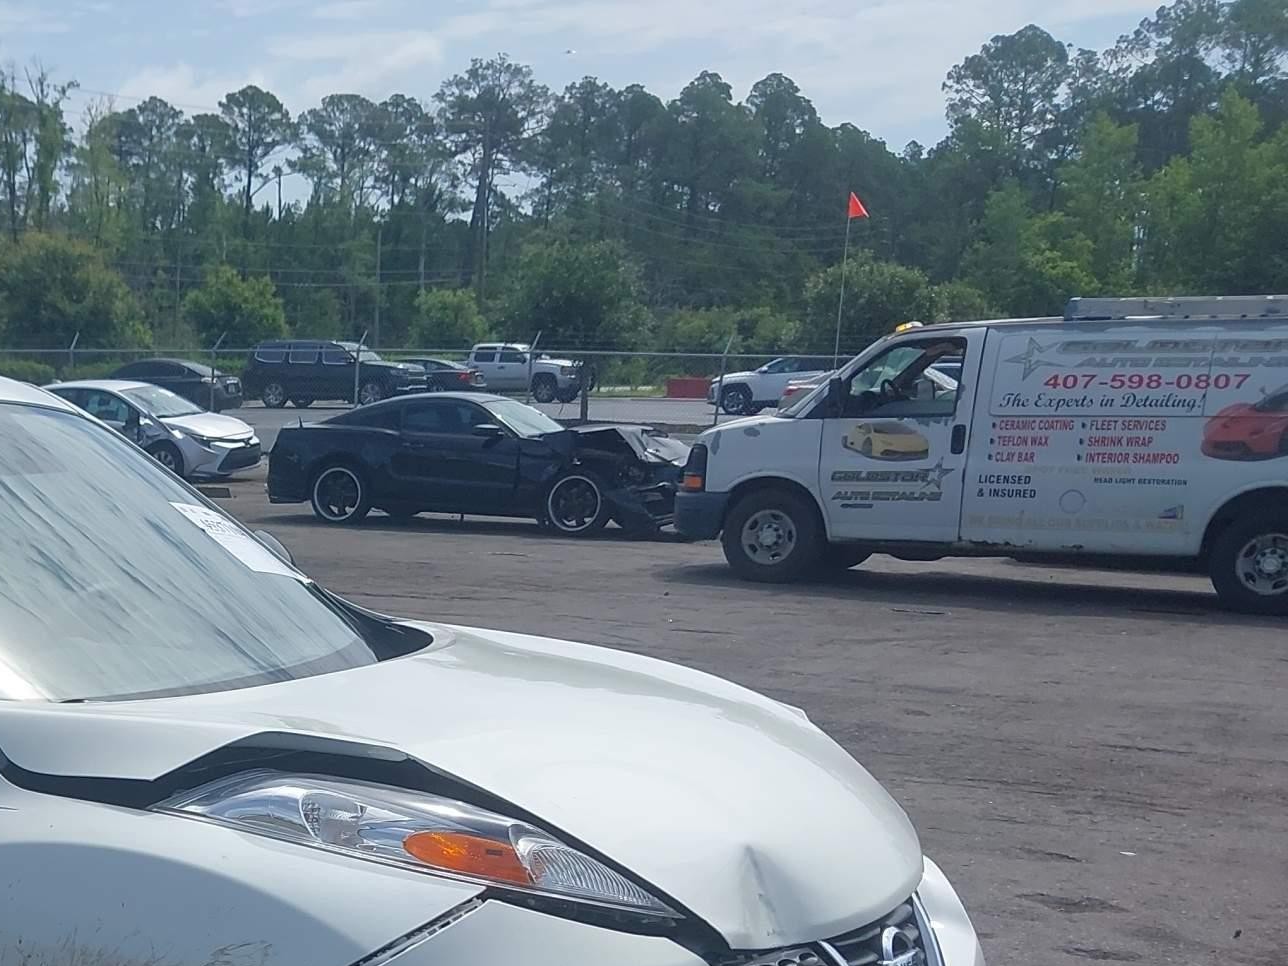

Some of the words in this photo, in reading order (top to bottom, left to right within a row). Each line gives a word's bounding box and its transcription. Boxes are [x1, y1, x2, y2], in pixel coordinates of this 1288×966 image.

[1044, 373, 1251, 390] 407-598-0807
[999, 393, 1030, 408] The
[1034, 393, 1094, 412] Experts
[1100, 394, 1115, 408] in
[1120, 392, 1206, 412] Detailing!
[999, 420, 1036, 431] CERAMIC
[1038, 419, 1075, 431] COATING
[1089, 420, 1118, 431] FLEET
[1120, 420, 1167, 432] SERVICES
[998, 436, 1028, 447] TEFLON
[1030, 436, 1049, 447] WAX
[1087, 436, 1124, 447] SHRINK
[1125, 436, 1153, 448] WRAP
[995, 452, 1016, 463] CLAY
[1017, 452, 1035, 463] BAR
[1085, 452, 1130, 464] INTERIOR
[1131, 453, 1180, 464] SHAMPOO
[978, 475, 1032, 486] LICENSED
[1115, 478, 1135, 486] LIGHT
[977, 488, 985, 498] &
[988, 488, 1037, 499] INSURED
